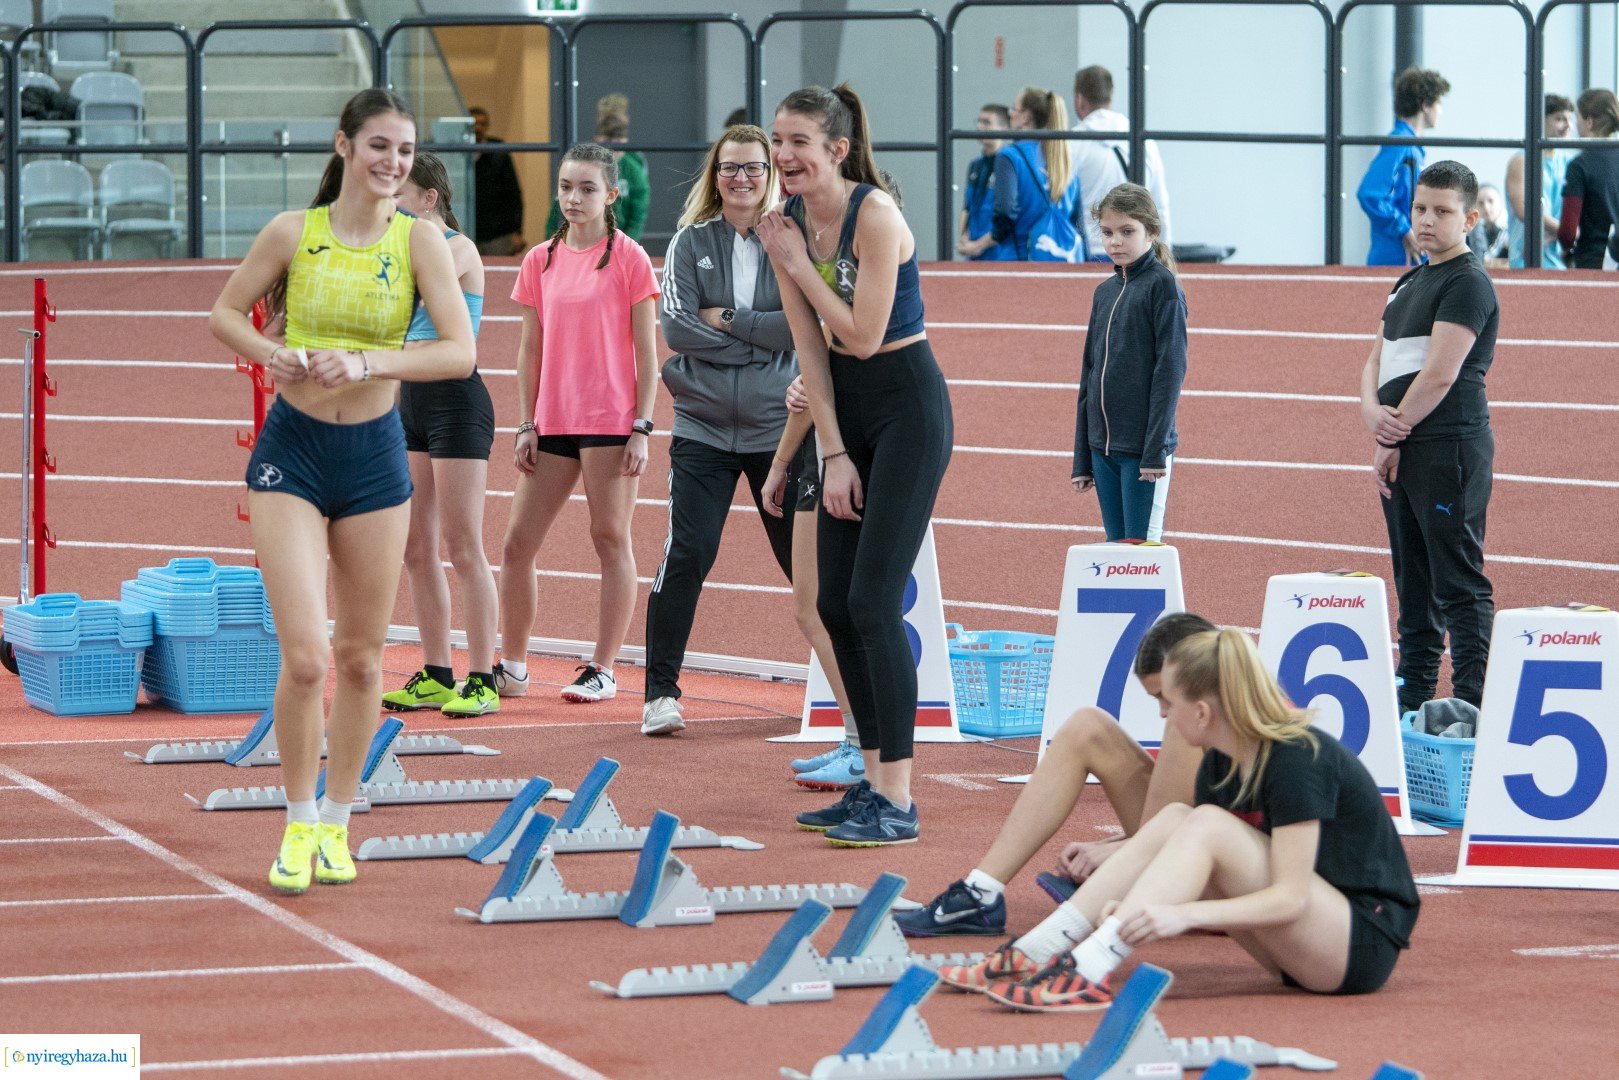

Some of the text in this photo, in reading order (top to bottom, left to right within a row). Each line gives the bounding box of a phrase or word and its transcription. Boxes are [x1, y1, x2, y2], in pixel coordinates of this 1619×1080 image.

[1106, 563, 1161, 577] polanik
[1308, 595, 1366, 610] polanik
[1077, 588, 1166, 721] 7
[1539, 631, 1603, 648] polanik
[1278, 622, 1371, 757] 6
[1503, 659, 1608, 821] 5
